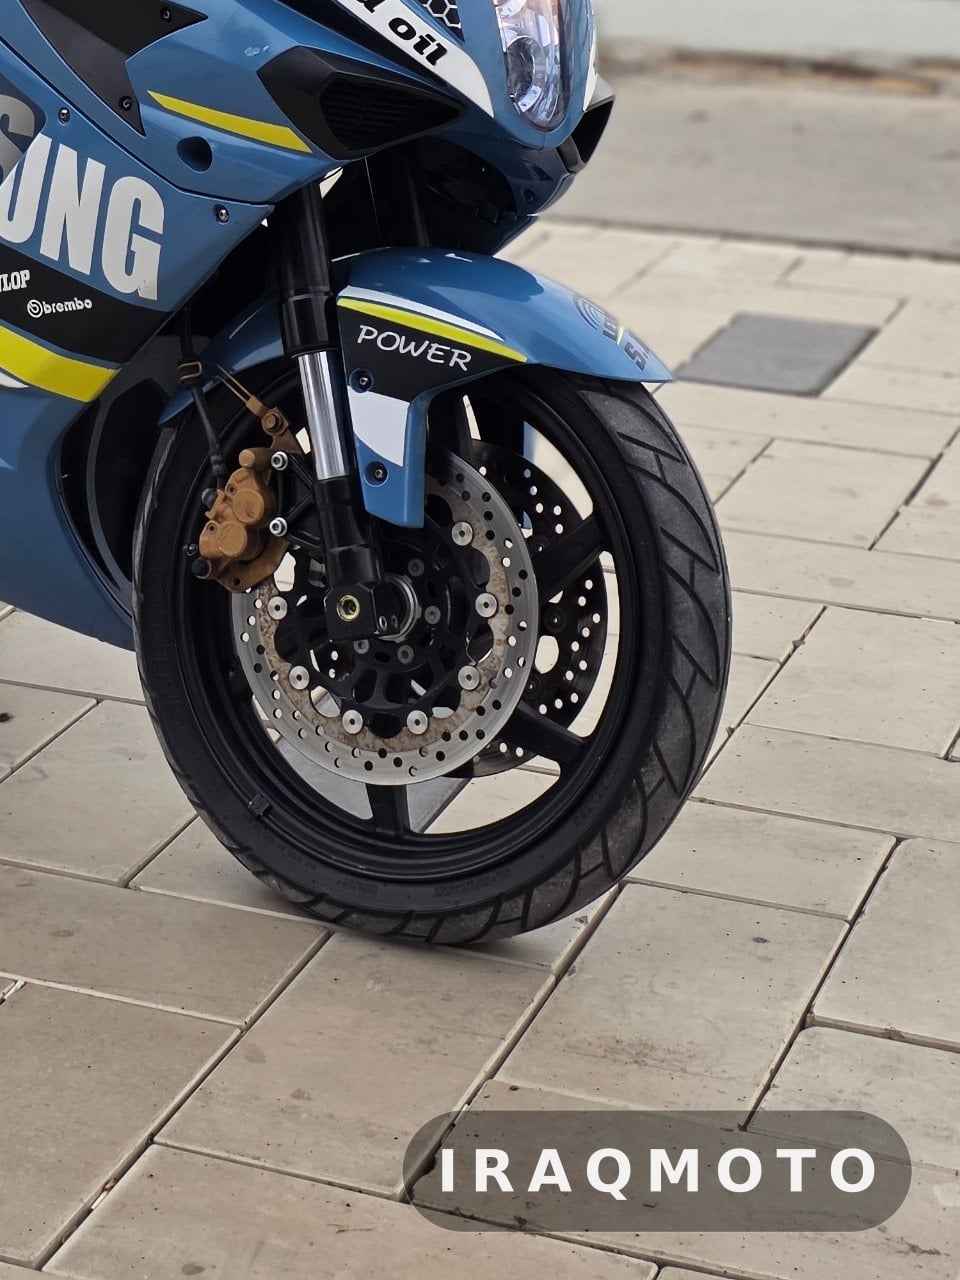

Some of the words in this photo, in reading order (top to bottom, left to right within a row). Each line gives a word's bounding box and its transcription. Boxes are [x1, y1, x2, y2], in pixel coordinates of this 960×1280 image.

[388, 17, 448, 66] oil
[43, 297, 93, 315] brembo
[356, 324, 472, 372] POWER
